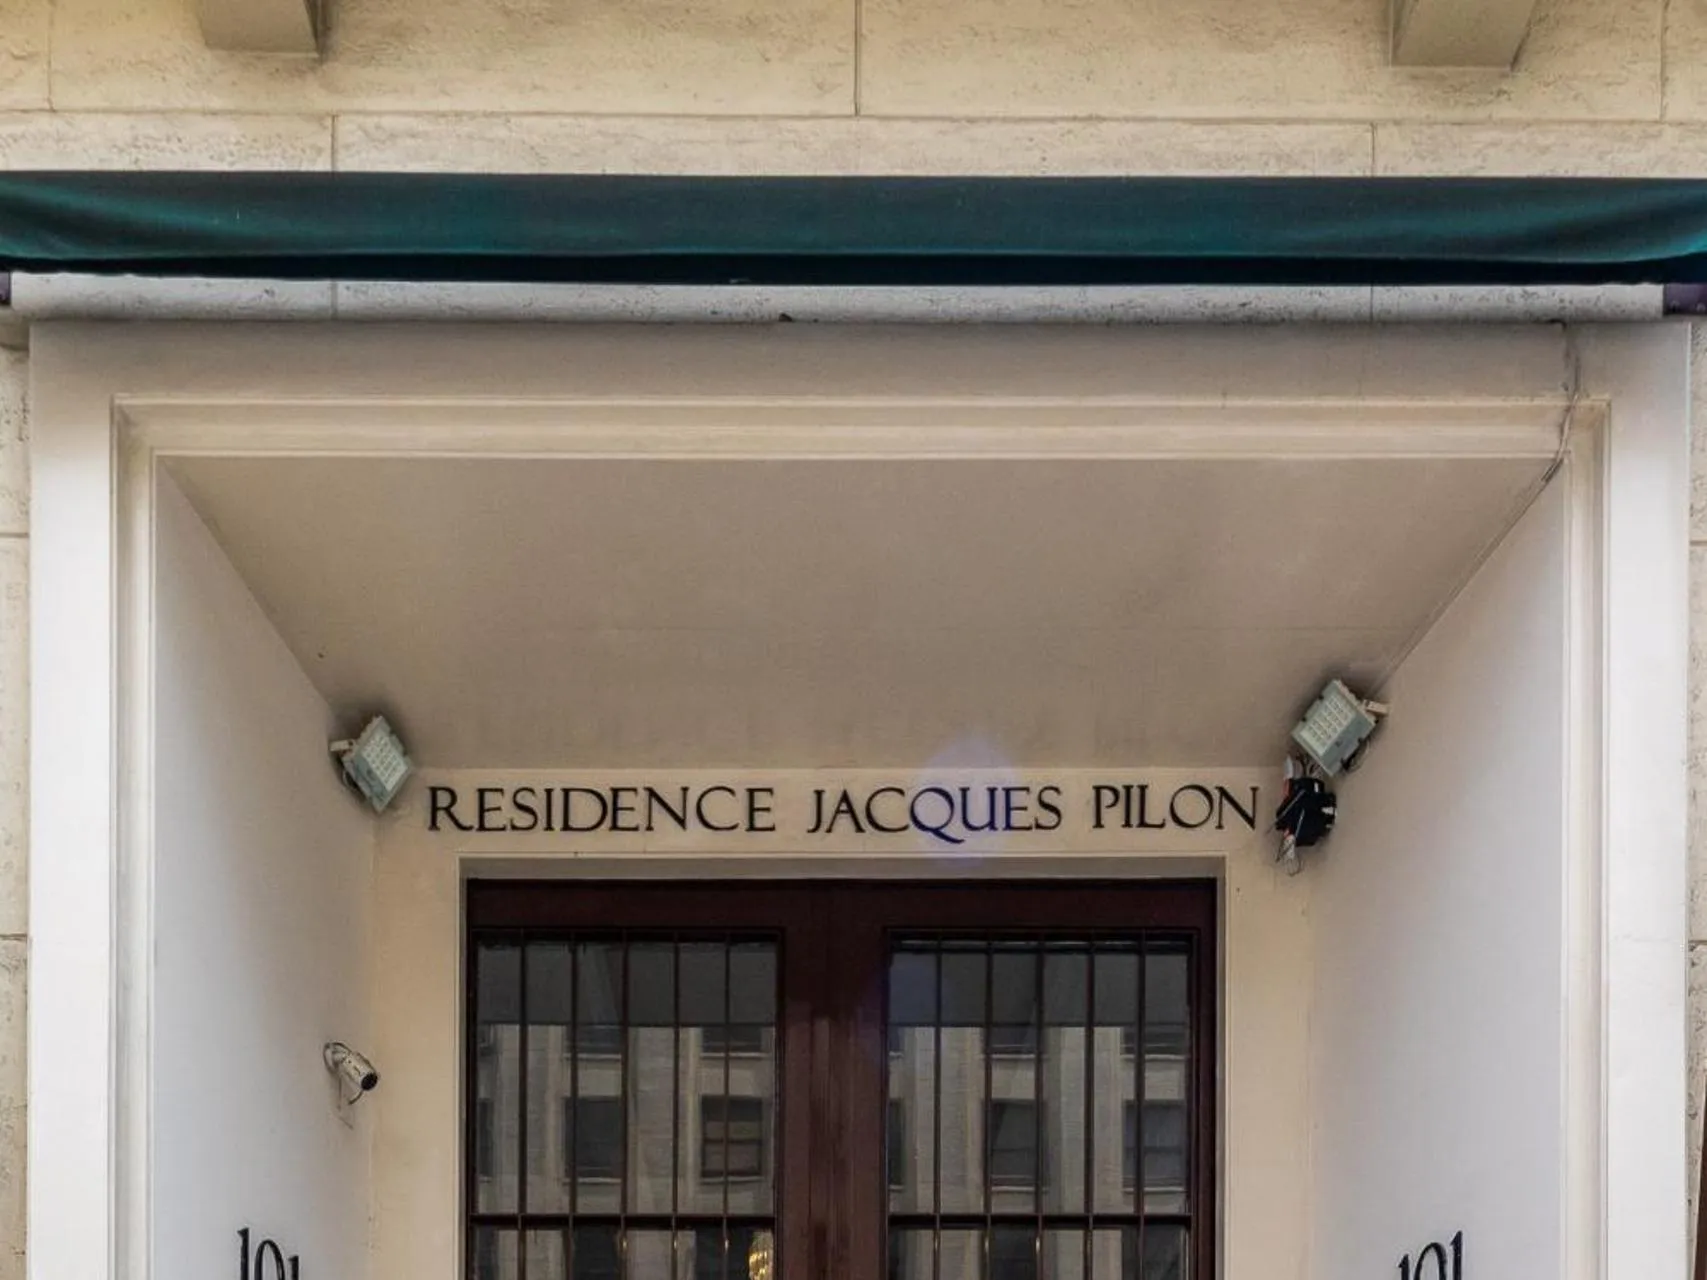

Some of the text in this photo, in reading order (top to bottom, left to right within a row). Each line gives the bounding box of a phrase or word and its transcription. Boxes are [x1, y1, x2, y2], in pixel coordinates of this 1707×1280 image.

[428, 784, 1260, 843] RESIDENCE JACQUES PILON
